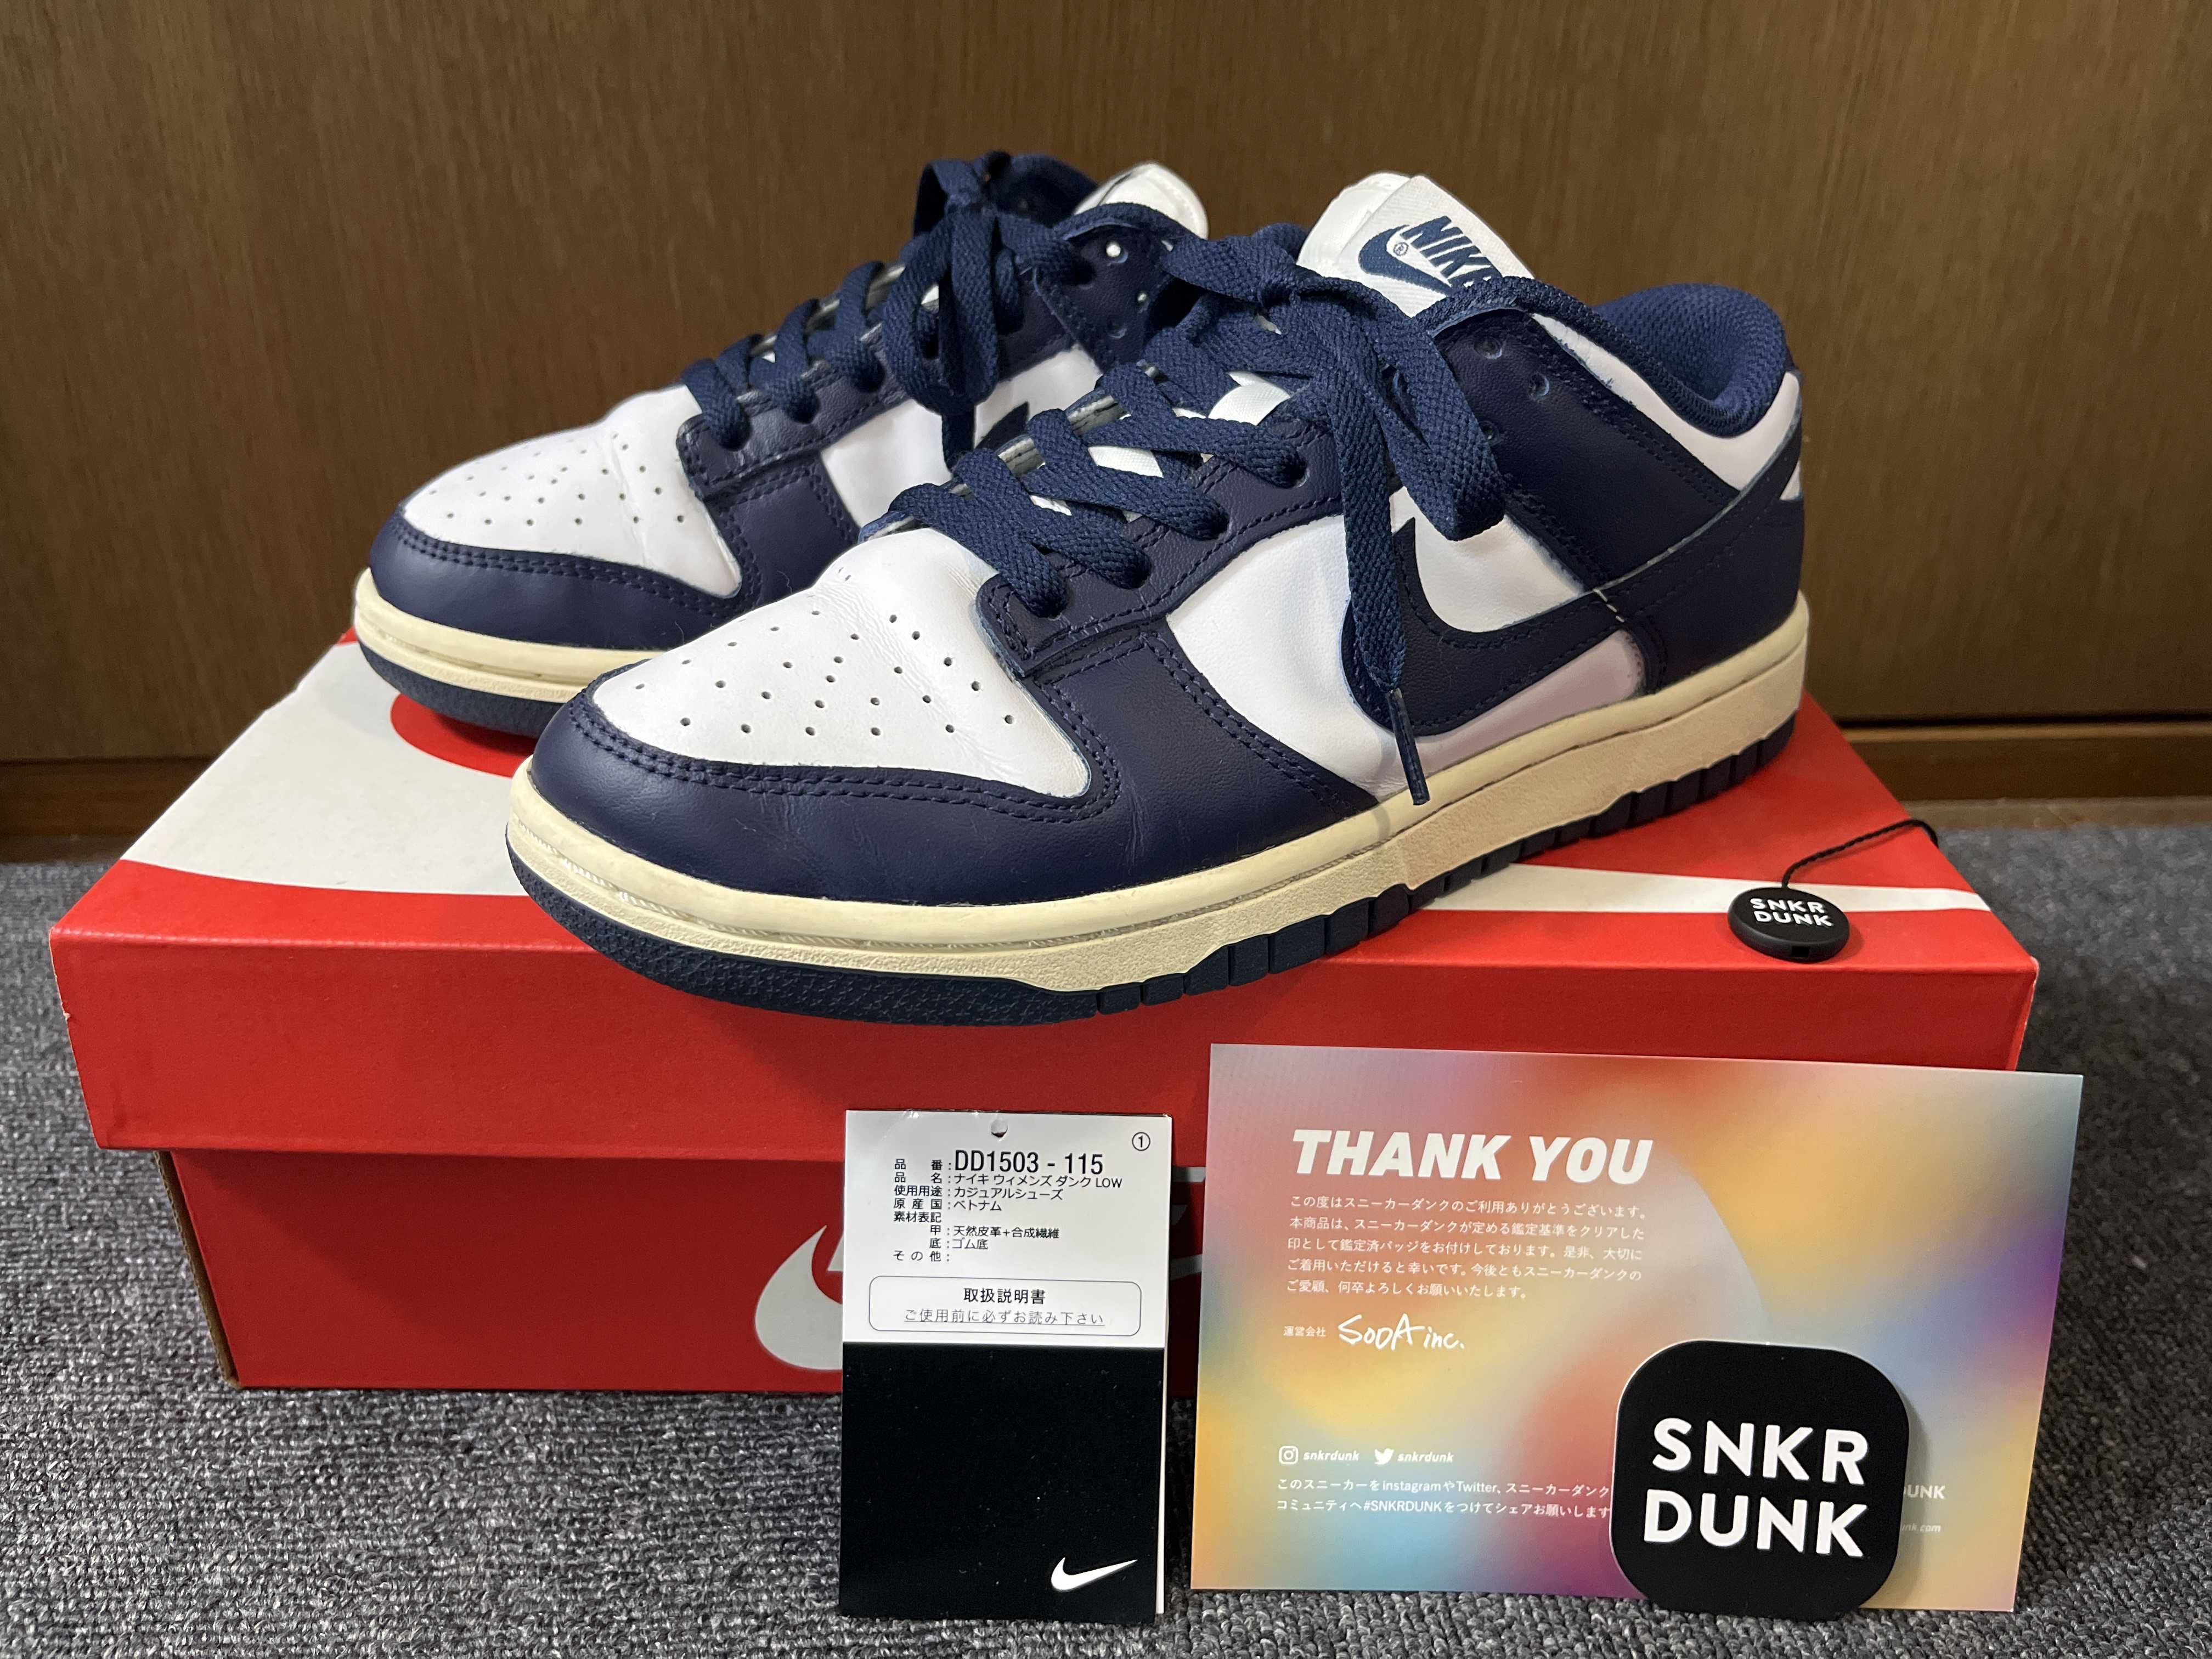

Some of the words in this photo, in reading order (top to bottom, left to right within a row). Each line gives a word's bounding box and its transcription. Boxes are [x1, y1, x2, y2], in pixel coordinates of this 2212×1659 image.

[1750, 898, 1825, 913] SNKR
[1753, 911, 1833, 927] DUNK
[955, 1149, 1039, 1172] DD1503
[1293, 1128, 1512, 1180] THANK
[1529, 1136, 1654, 1184] YOU
[1290, 1195, 1645, 1220] この度はスニーカーダンクのご利用ありがとうございます。
[893, 1211, 942, 1223] 素材表記
[963, 1288, 1046, 1305] 取扱説明書
[905, 1308, 1103, 1325] ご使用前に必ずお読み下さい
[1283, 1326, 1326, 1337] 運営会社
[1423, 1327, 1465, 1349] inc.
[1304, 1450, 1360, 1462] snkrdunk
[1397, 1452, 1454, 1463] snkrdunk
[1652, 1417, 1868, 1485] SNKR
[1904, 1485, 1946, 1499] UNK
[1644, 1488, 1867, 1558] DUNK
